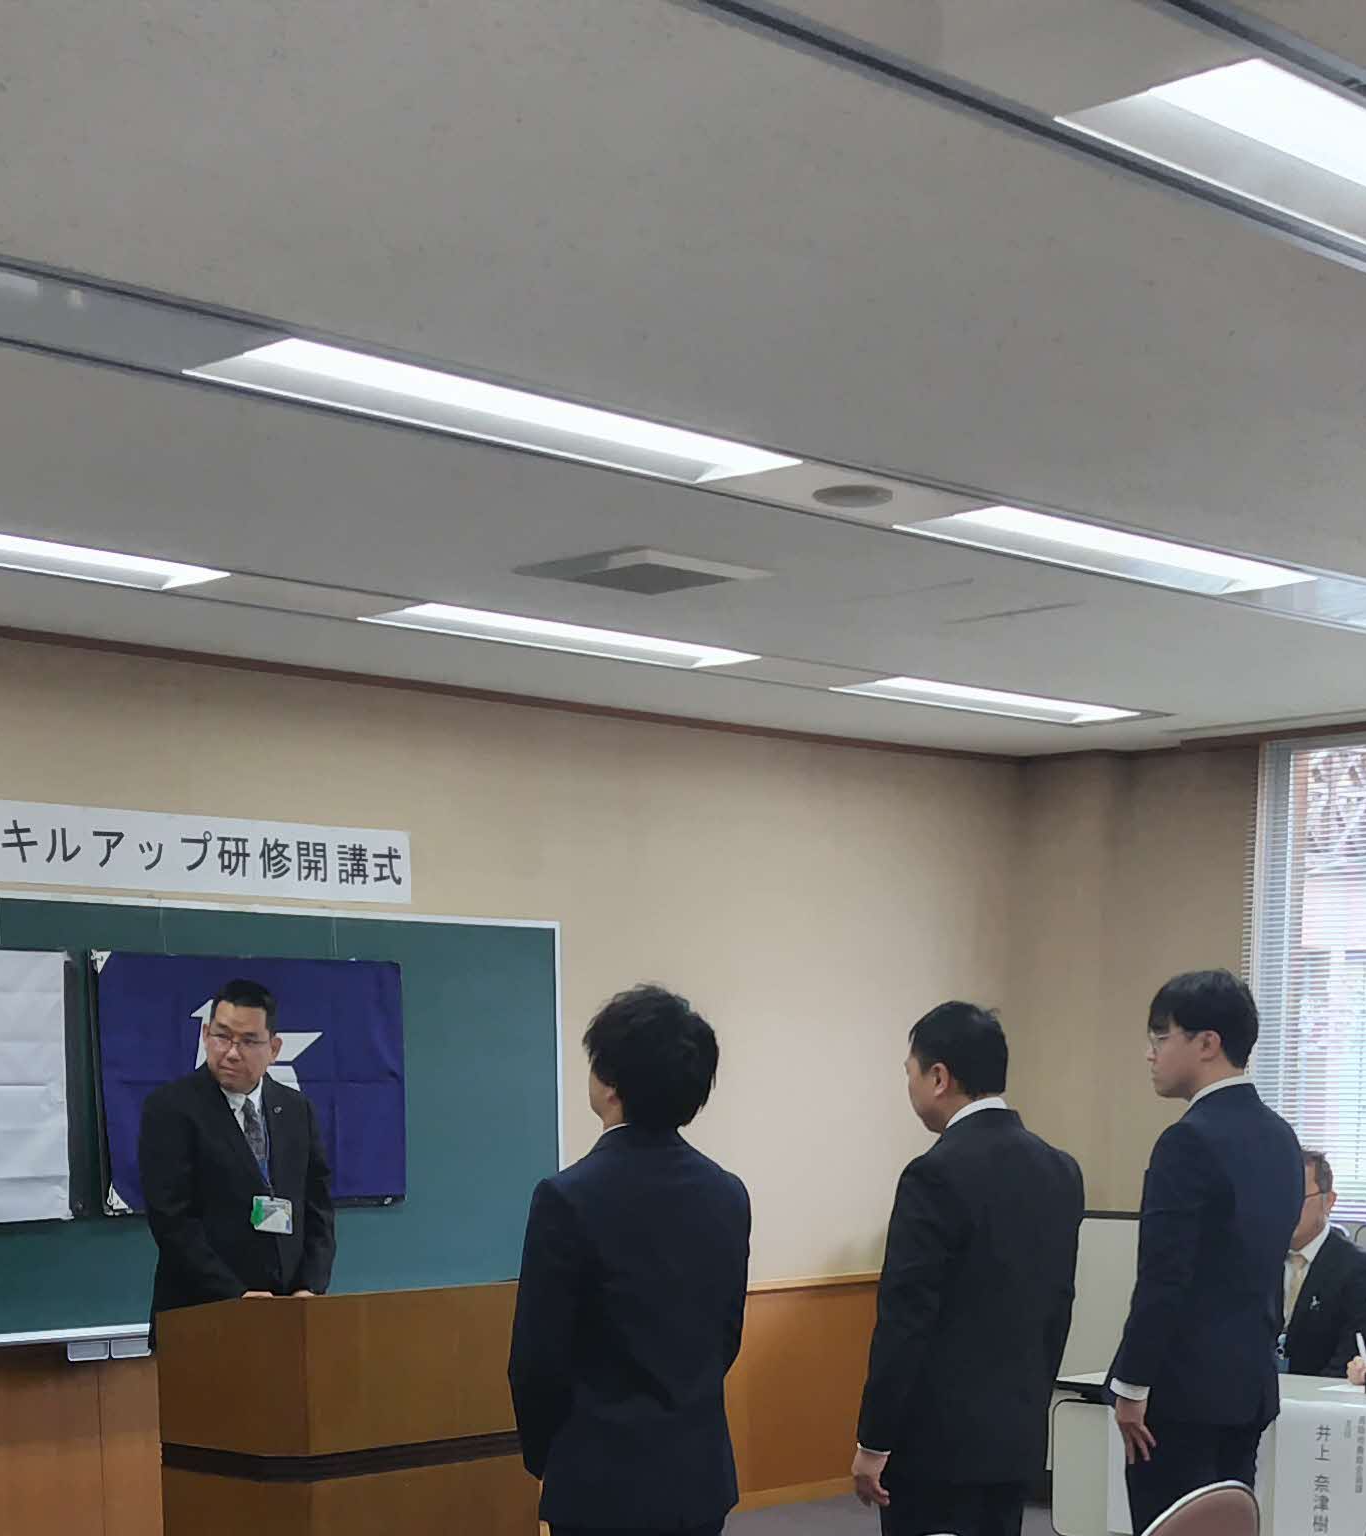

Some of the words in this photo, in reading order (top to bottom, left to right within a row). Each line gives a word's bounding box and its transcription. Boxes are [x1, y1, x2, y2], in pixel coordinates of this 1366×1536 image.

[1314, 1424, 1331, 1461] 井上
[1312, 1474, 1330, 1534] 奈津樹
